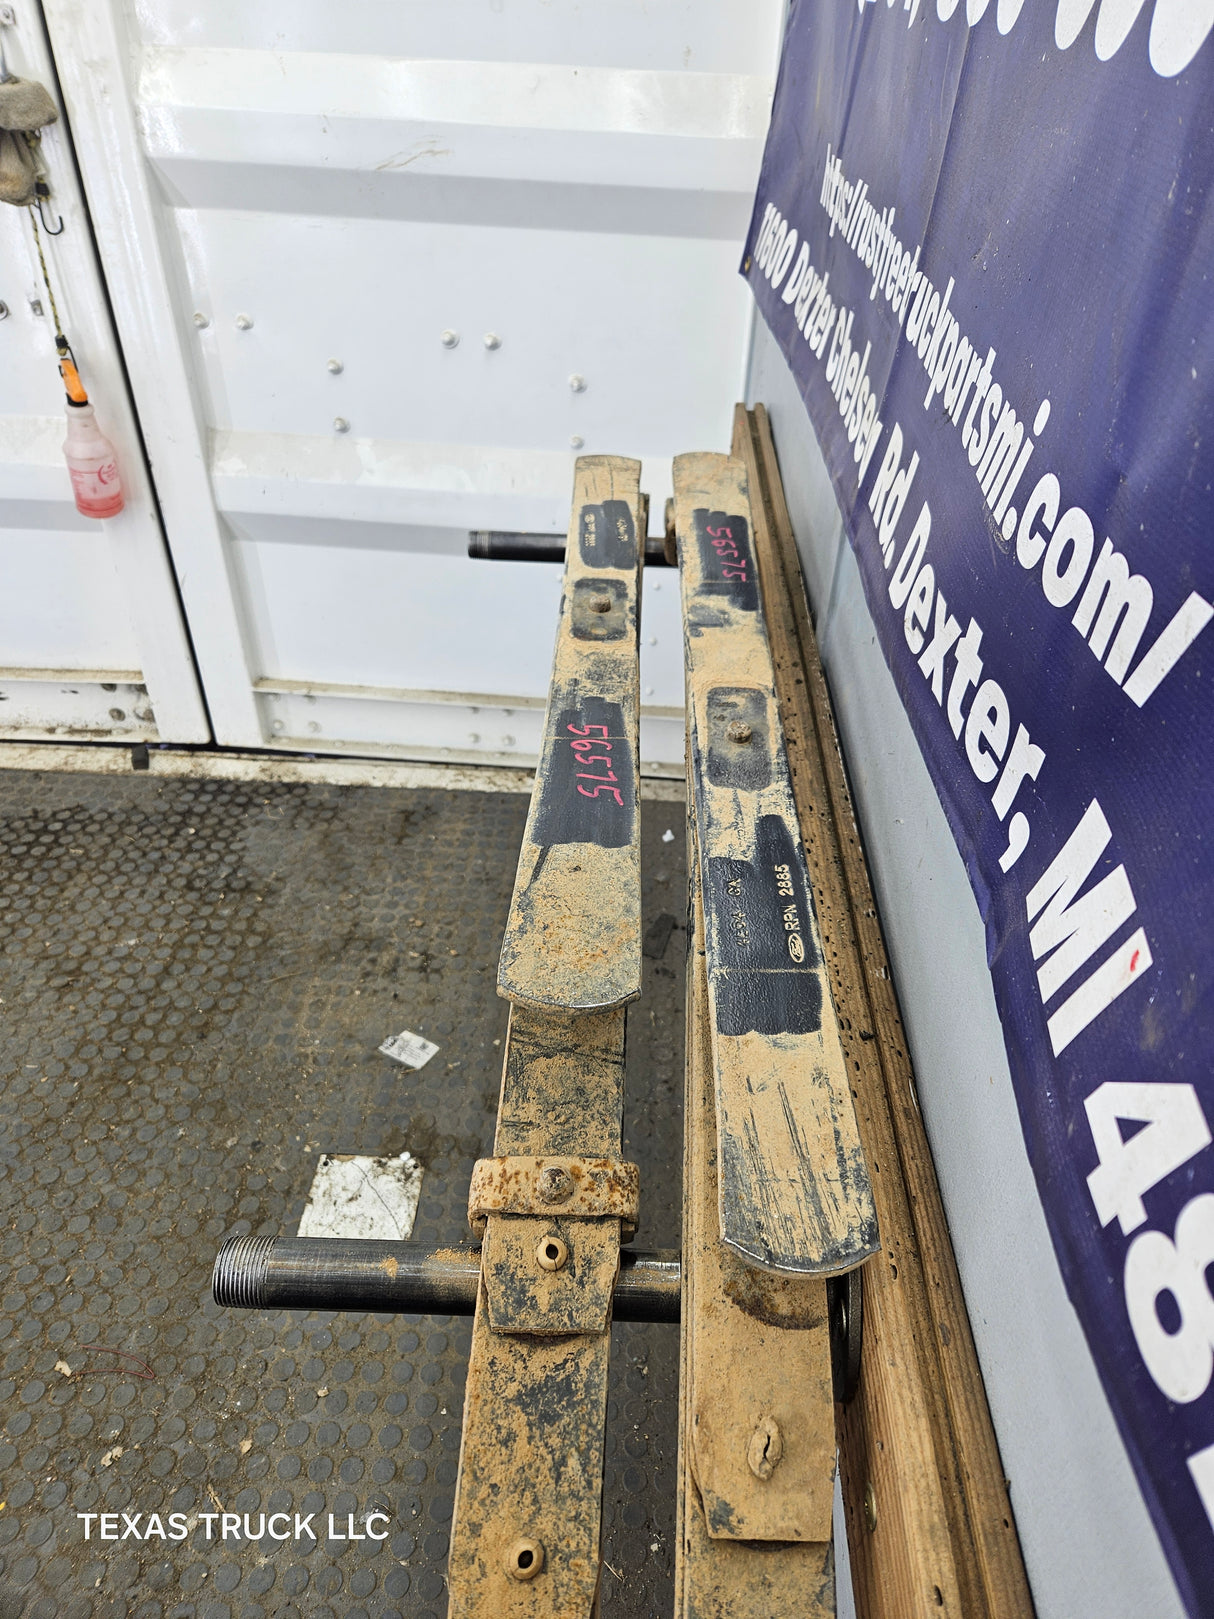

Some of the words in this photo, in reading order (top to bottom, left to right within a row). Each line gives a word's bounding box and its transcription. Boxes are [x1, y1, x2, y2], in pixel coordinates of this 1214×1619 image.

[781, 241, 837, 360] Dexter
[706, 525, 746, 583] 56575
[868, 421, 920, 570] Rd.
[888, 500, 1046, 874] Dexter,
[775, 863, 794, 896] 2885
[783, 904, 800, 931] RPN
[1026, 797, 1153, 1059] MI
[1084, 1081, 1214, 1533] 48
